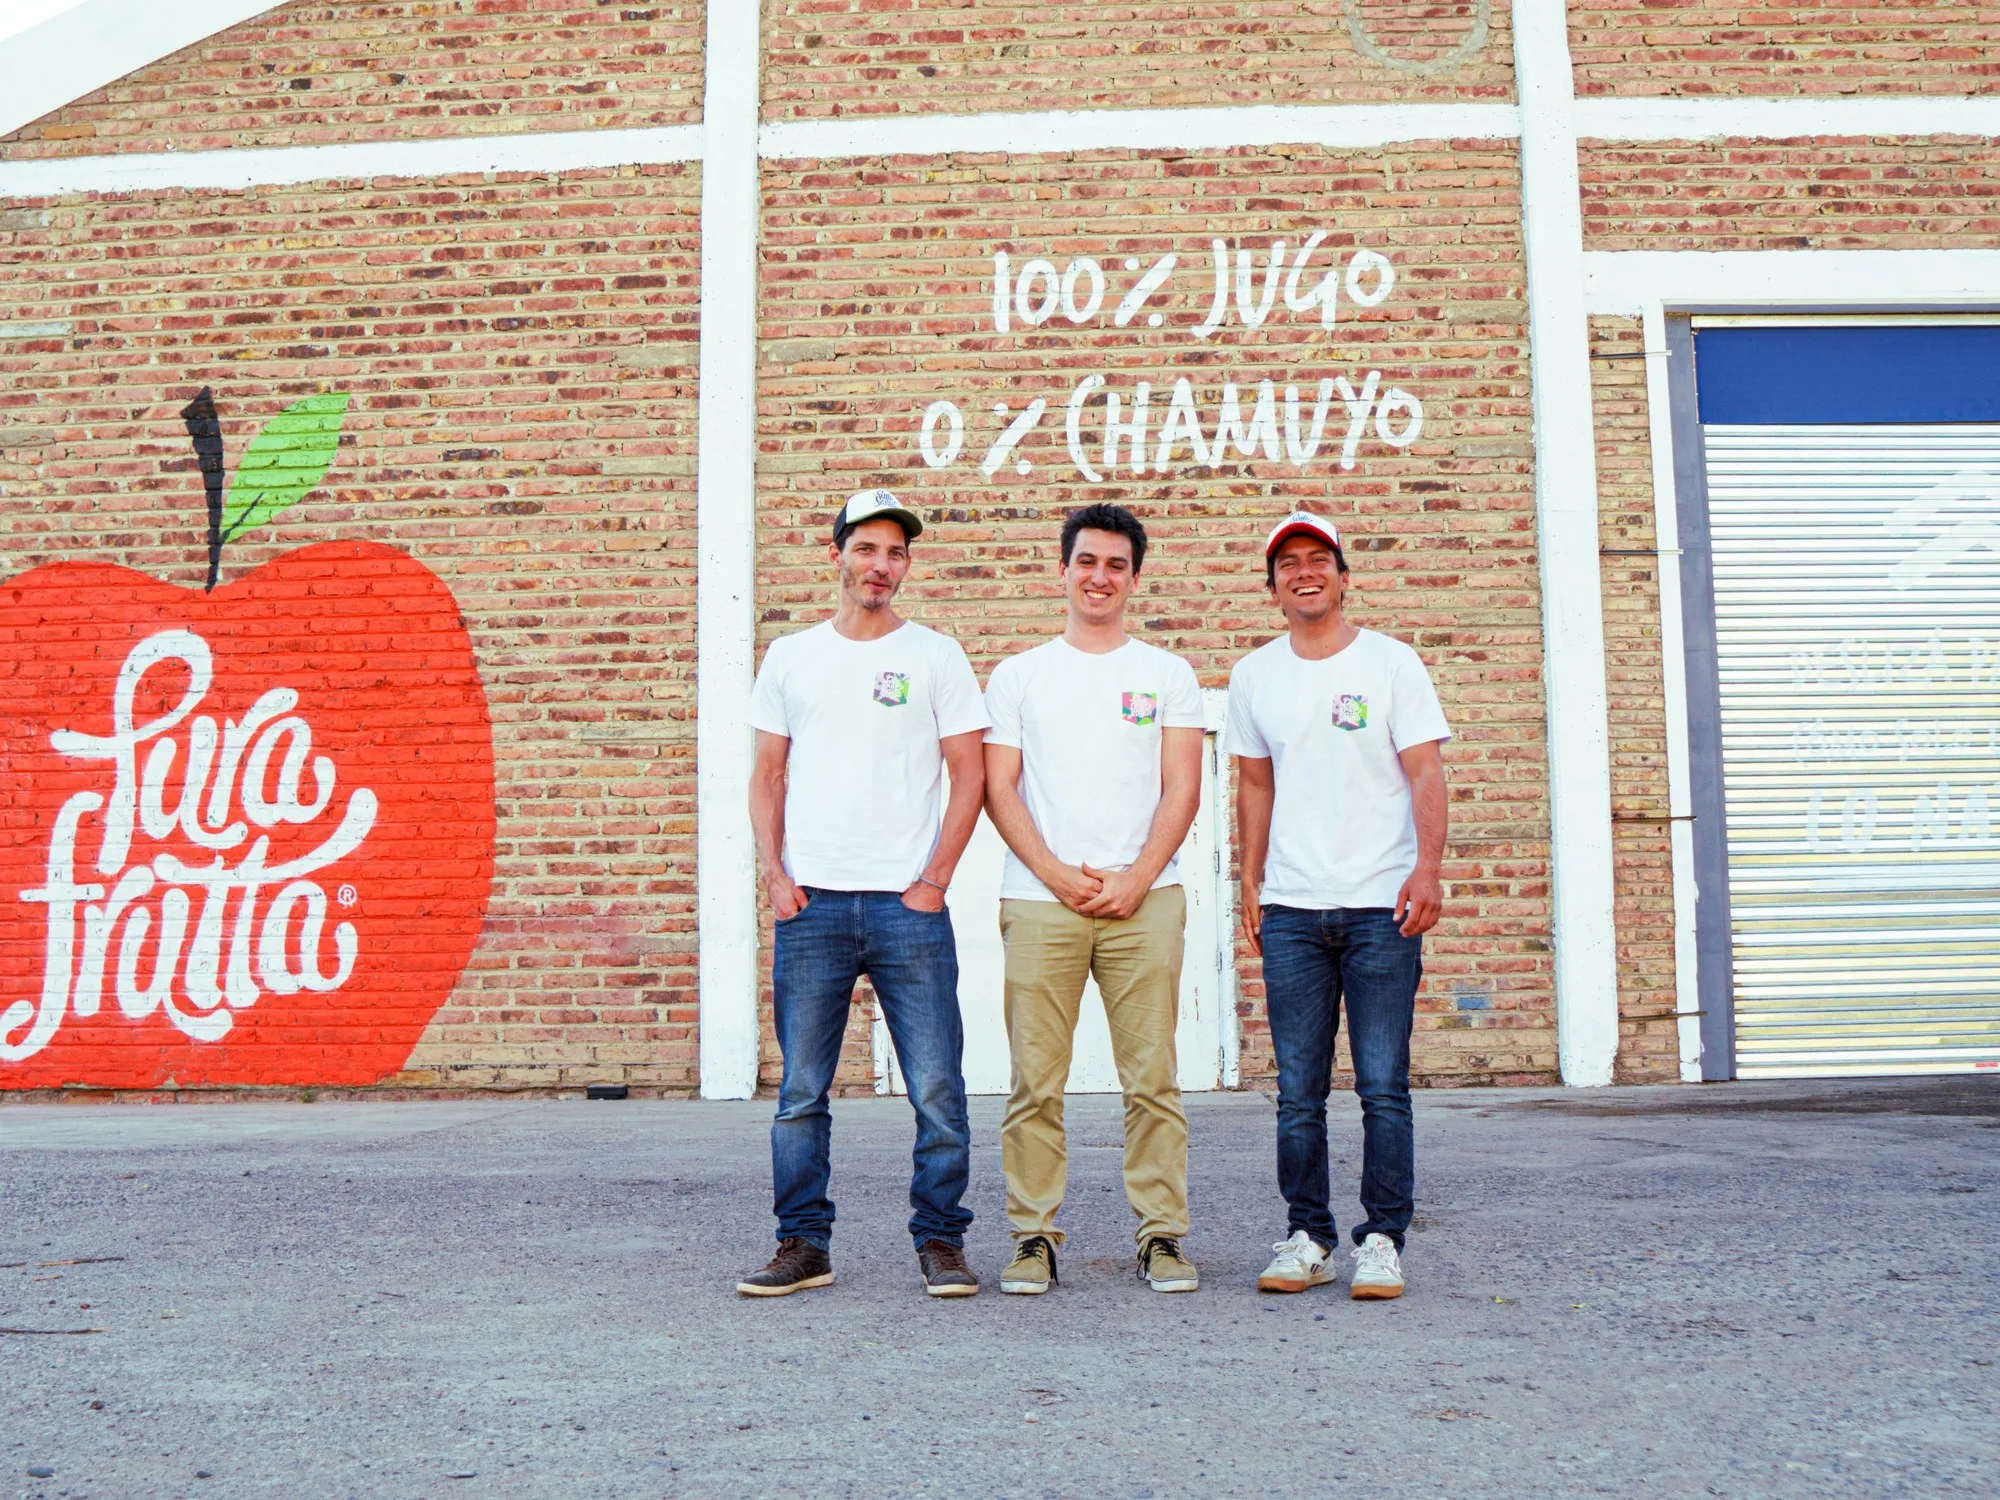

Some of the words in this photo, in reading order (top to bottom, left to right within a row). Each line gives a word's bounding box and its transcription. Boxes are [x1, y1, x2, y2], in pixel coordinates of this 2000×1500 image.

[993, 250, 1178, 334] 100%
[1191, 229, 1396, 338] JUGO
[1065, 370, 1425, 483] CHAMUYO
[1806, 787, 1878, 854] LO
[1911, 780, 2000, 852] NA
